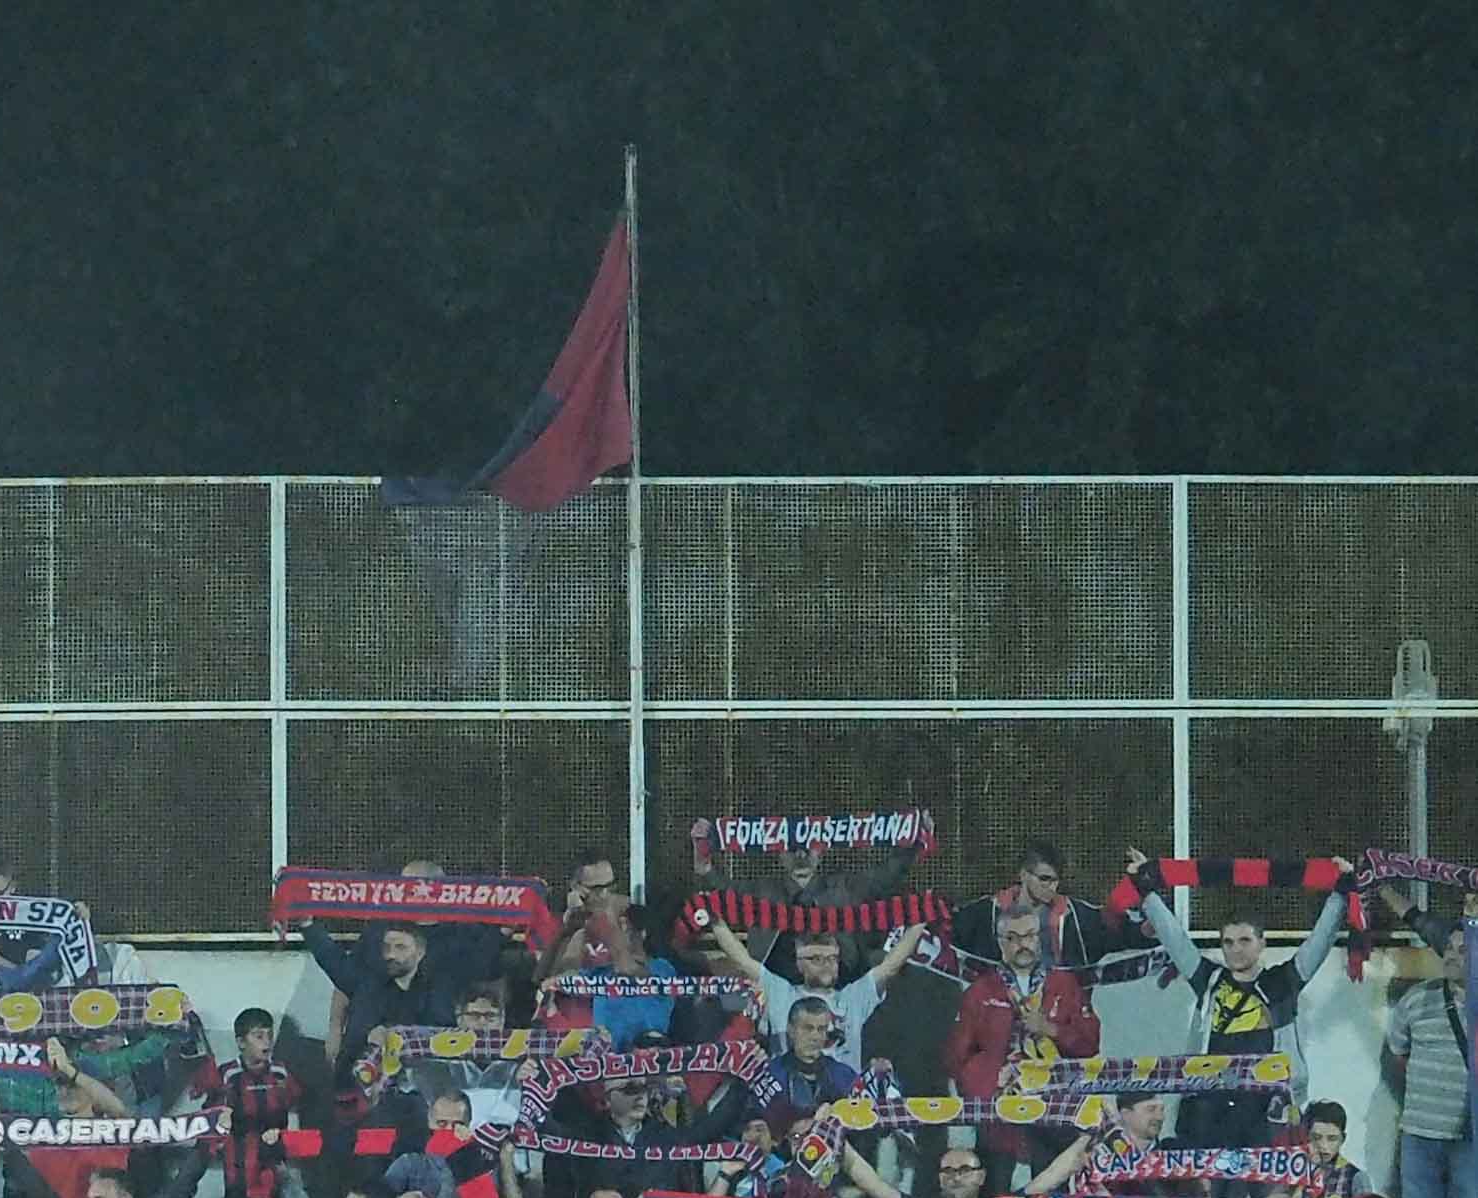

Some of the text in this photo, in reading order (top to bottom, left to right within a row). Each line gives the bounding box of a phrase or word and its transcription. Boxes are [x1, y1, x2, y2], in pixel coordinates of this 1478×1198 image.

[726, 814, 914, 845] FORZA CASERTANA
[615, 986, 658, 996] VINCE
[8, 1116, 211, 1145] CASERTANA
